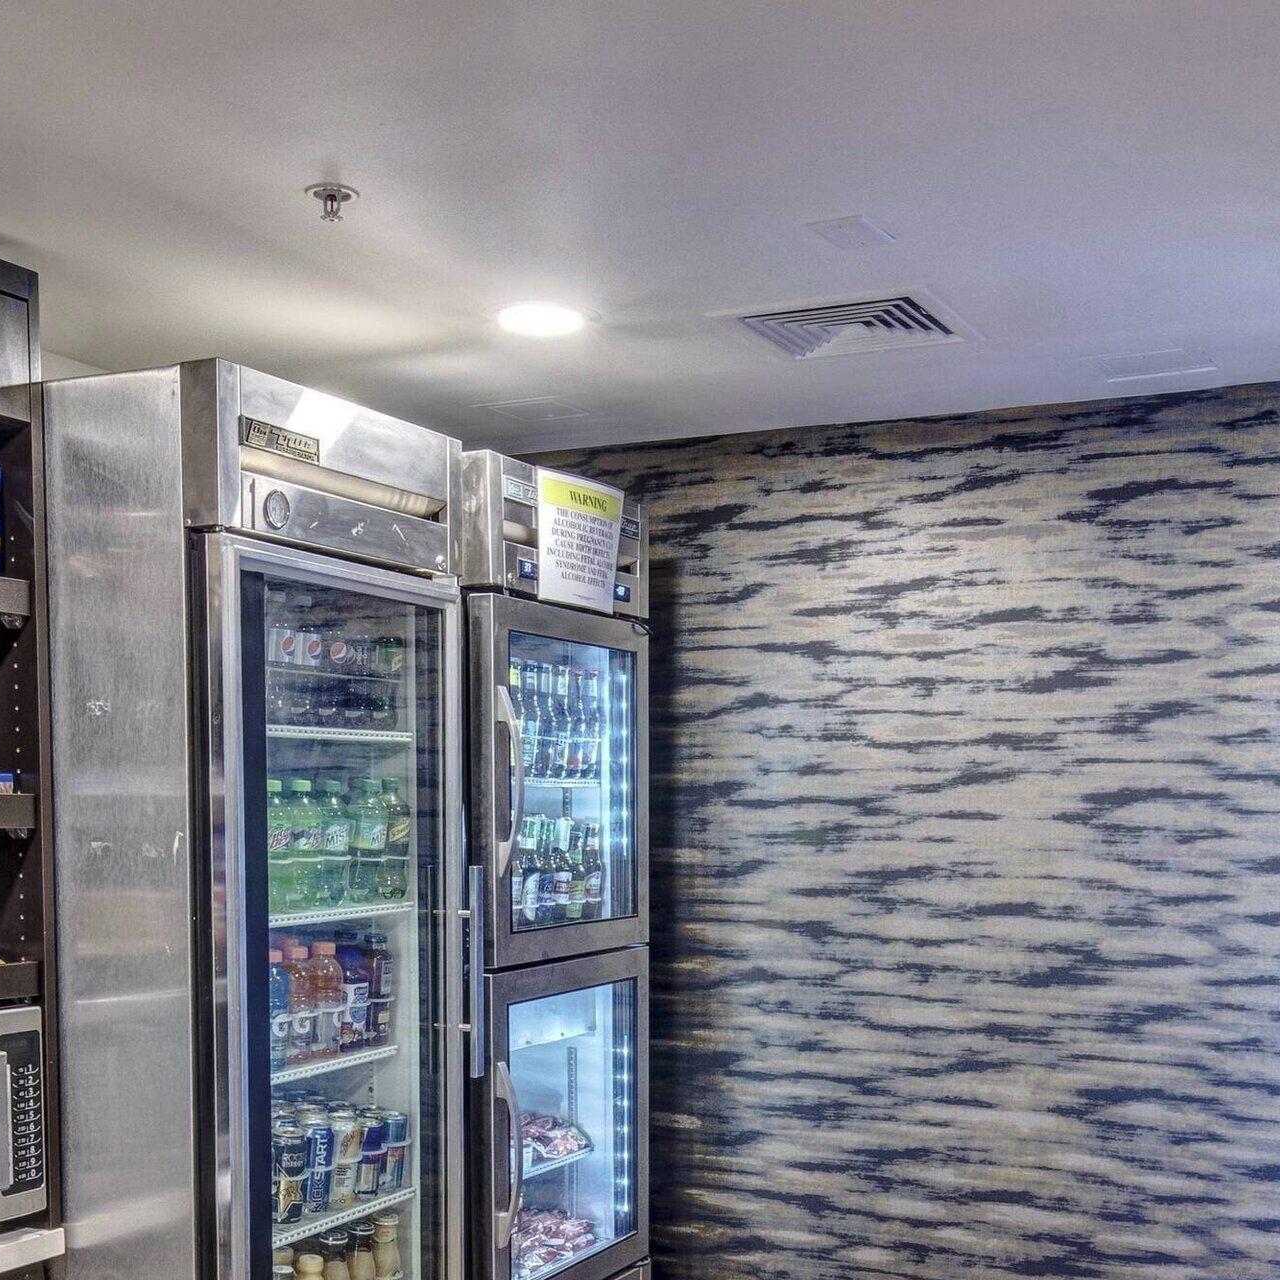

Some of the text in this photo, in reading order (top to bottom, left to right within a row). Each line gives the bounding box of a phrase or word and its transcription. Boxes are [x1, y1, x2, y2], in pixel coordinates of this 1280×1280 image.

[569, 490, 607, 512] WARNING
[556, 507, 569, 517] THE
[553, 517, 588, 534] ALCOHOLIC
[551, 527, 576, 541] DURING
[576, 532, 606, 548] PREGNANCY
[555, 538, 575, 550] CAUSE
[575, 543, 592, 554] BIRTH
[547, 546, 580, 561] INCLUDING
[555, 560, 587, 574] SYNDROME
[586, 576, 606, 589] EFFECTS
[28, 1064, 33, 1072] 1
[28, 1076, 33, 1084] 2
[29, 1099, 34, 1107] 4
[29, 1111, 35, 1119] 5
[29, 1122, 35, 1130] 6
[30, 1134, 35, 1142] 7
[30, 1157, 36, 1165] 9
[30, 1169, 36, 1177] 0
